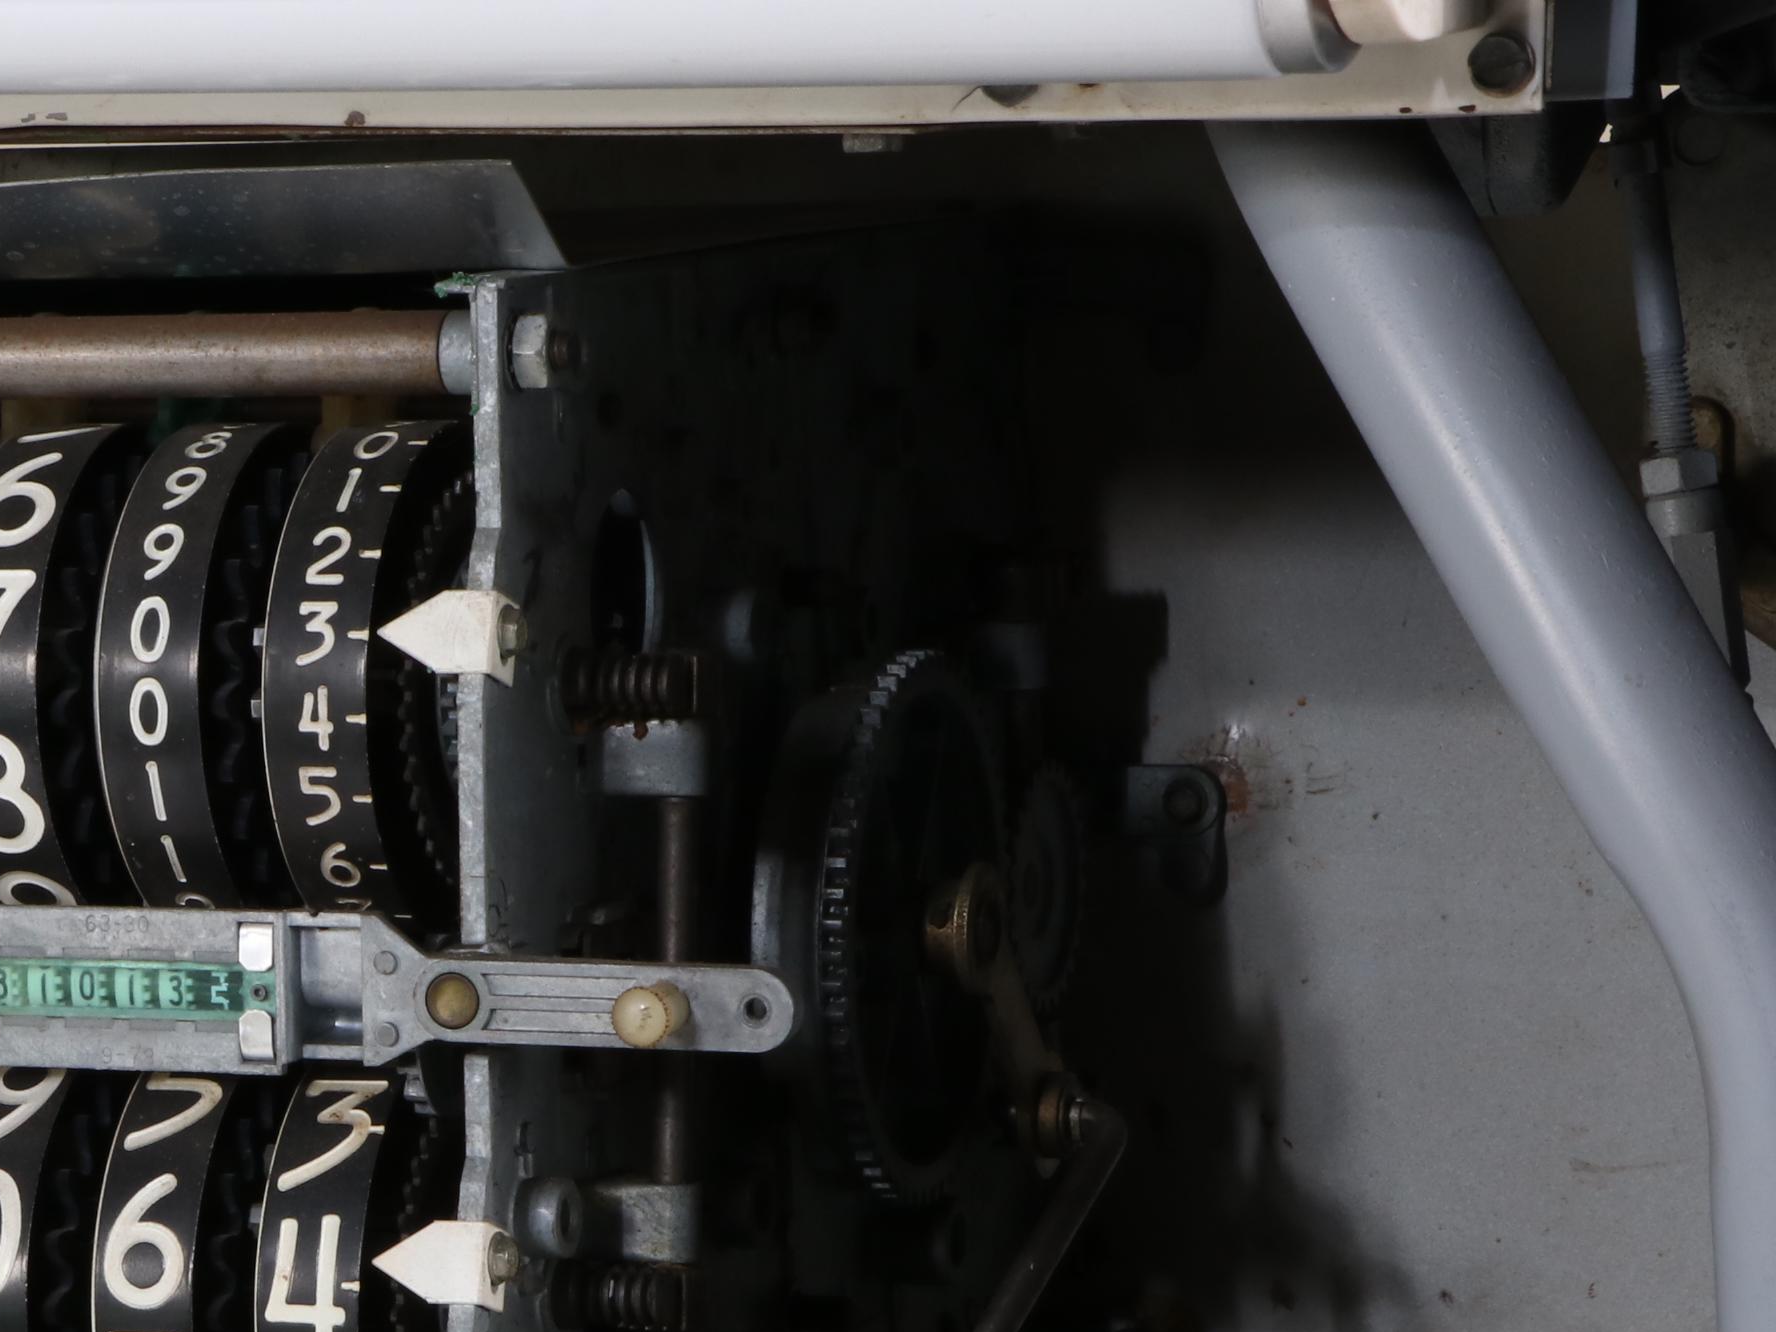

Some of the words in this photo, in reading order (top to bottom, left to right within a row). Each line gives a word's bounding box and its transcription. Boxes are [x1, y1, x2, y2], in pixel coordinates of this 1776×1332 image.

[162, 466, 208, 511] 9
[336, 468, 363, 513] 1
[142, 523, 185, 581] 9
[304, 526, 353, 586] 2
[130, 595, 170, 664] 0
[296, 601, 336, 667] 3
[129, 676, 169, 746] 0
[298, 685, 335, 751] 4
[298, 766, 341, 826] 5
[319, 842, 363, 888] 6
[104, 1173, 184, 1310] 6
